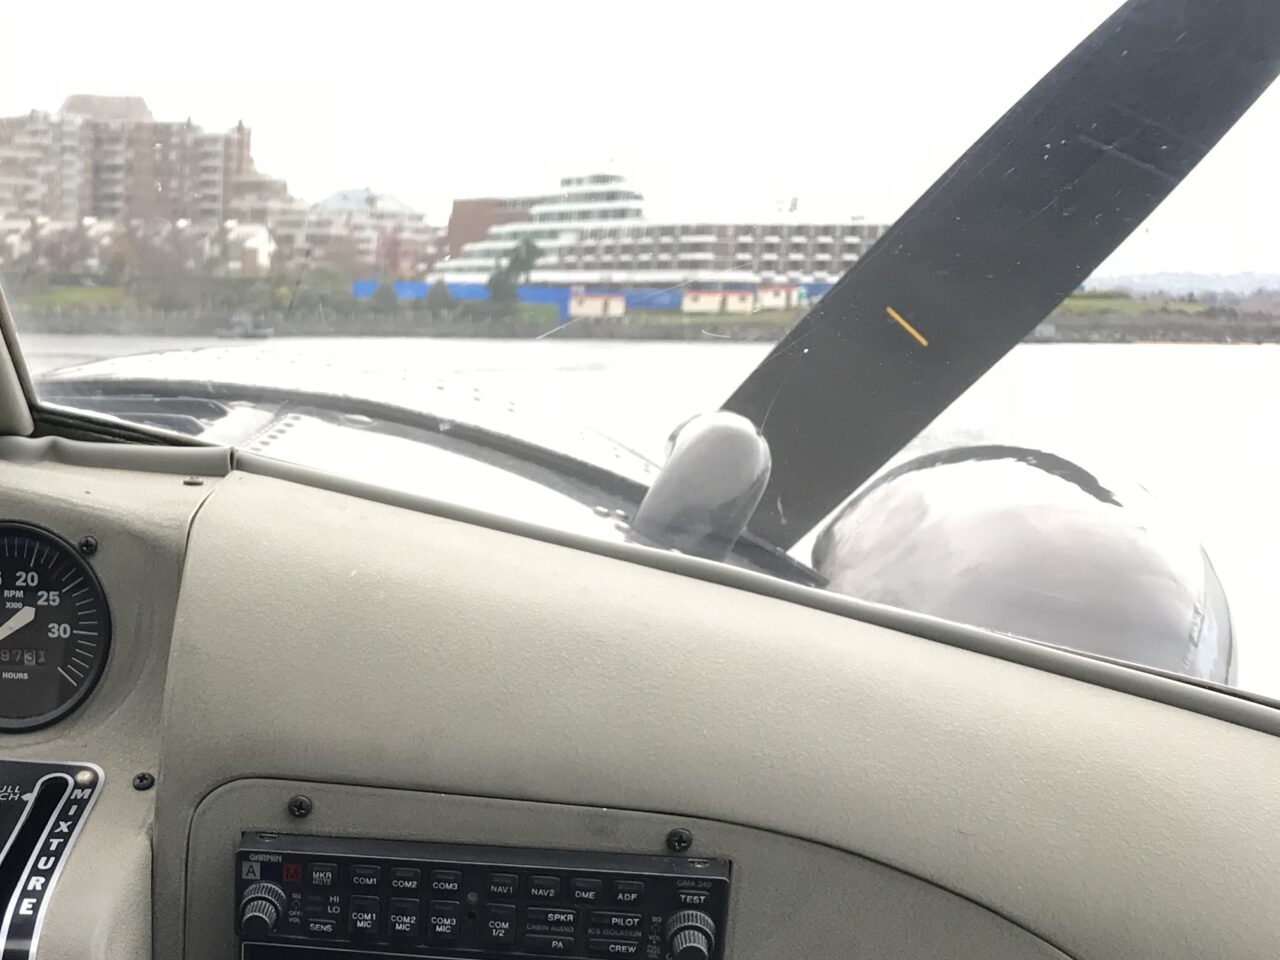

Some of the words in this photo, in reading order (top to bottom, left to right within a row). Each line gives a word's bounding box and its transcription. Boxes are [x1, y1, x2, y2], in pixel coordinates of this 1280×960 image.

[15, 571, 39, 588] 20
[4, 590, 24, 598] RPM
[37, 591, 60, 607] 25
[48, 623, 71, 639] 30
[2, 672, 29, 680] HOURS
[18, 787, 91, 916] MIXTURE
[353, 876, 377, 885] COM1
[392, 880, 417, 888] COM2
[432, 882, 458, 891] COM3
[490, 884, 514, 895] NAV1
[531, 888, 555, 897] NAV2
[575, 890, 596, 900] DME
[617, 892, 638, 901] ADF
[680, 895, 707, 904] TEST
[391, 915, 416, 924] COM2
[431, 917, 457, 925] COM3
[547, 913, 574, 923] SPKR
[611, 917, 640, 927] PILOT
[309, 923, 333, 933] SENS
[488, 920, 510, 929] COM
[608, 944, 637, 953] CREW
